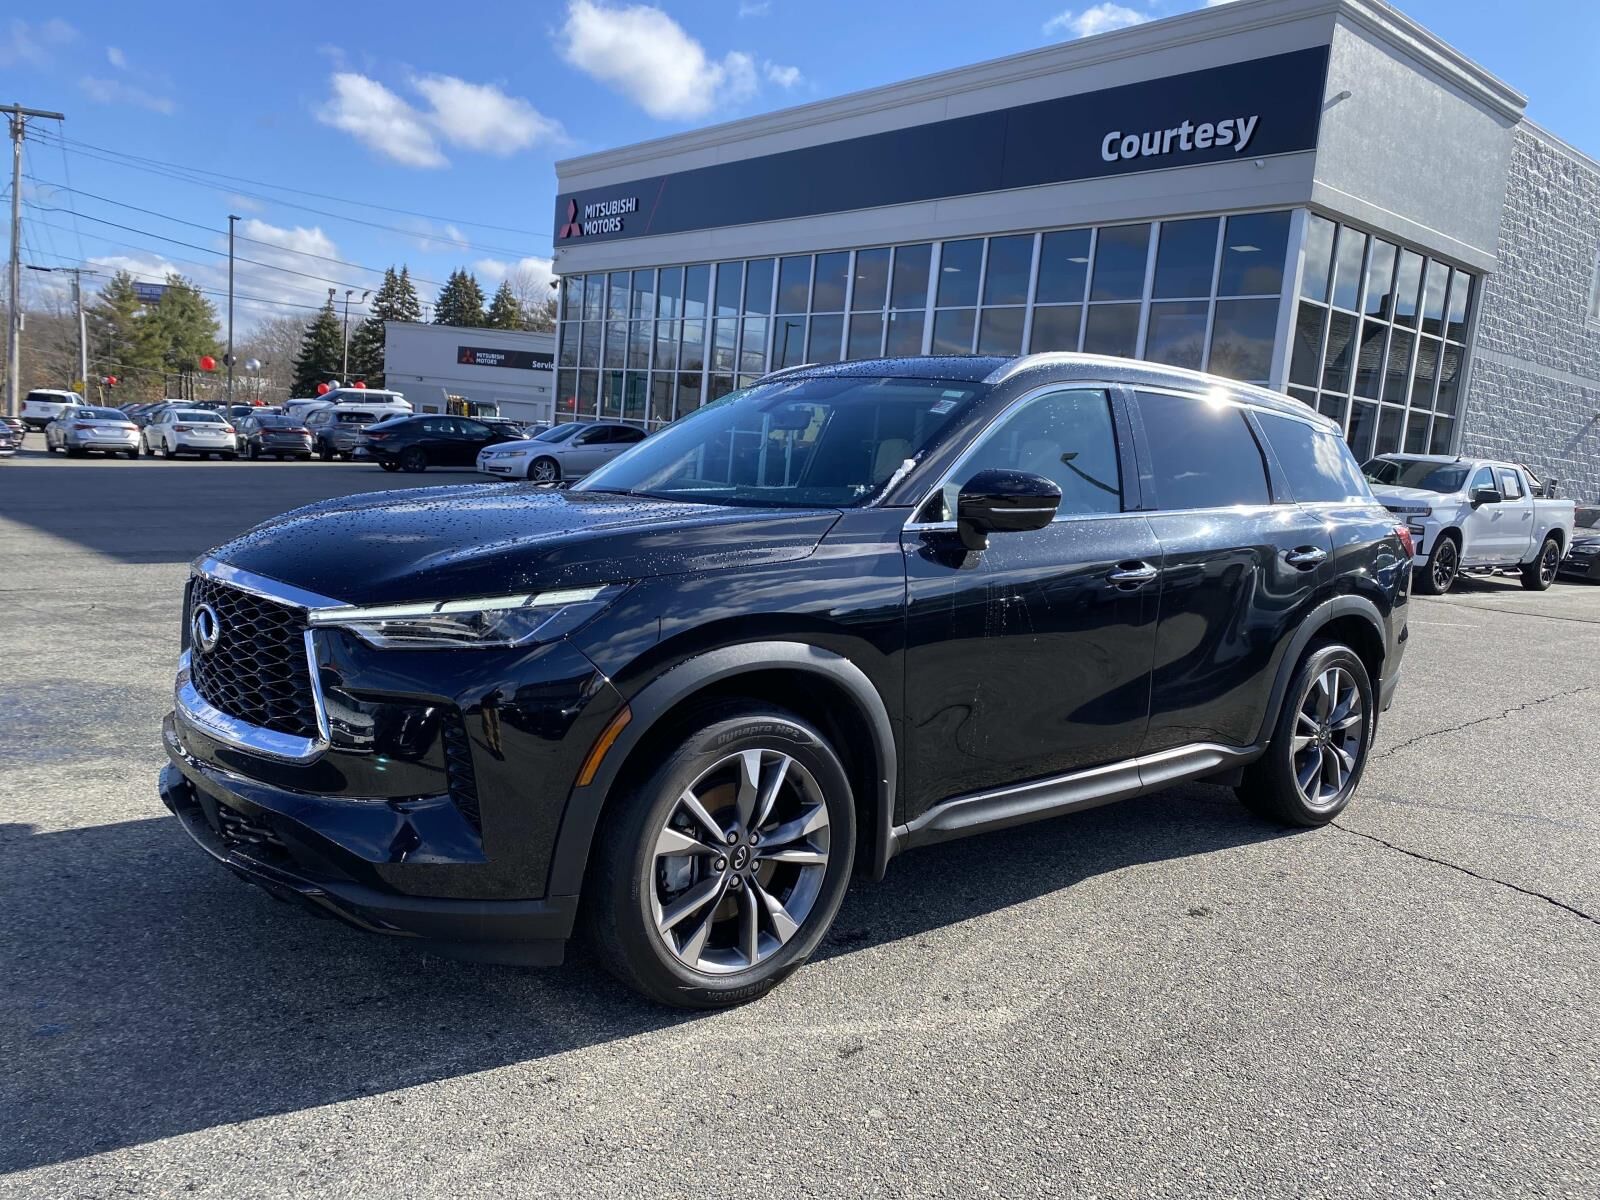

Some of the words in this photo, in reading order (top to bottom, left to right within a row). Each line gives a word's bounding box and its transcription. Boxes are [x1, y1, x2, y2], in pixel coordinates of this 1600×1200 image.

[1101, 115, 1258, 161] Courtesy
[584, 198, 636, 218] MITSUBISHI
[583, 217, 622, 236] MOTORS
[476, 352, 504, 360] MITSUBISHI
